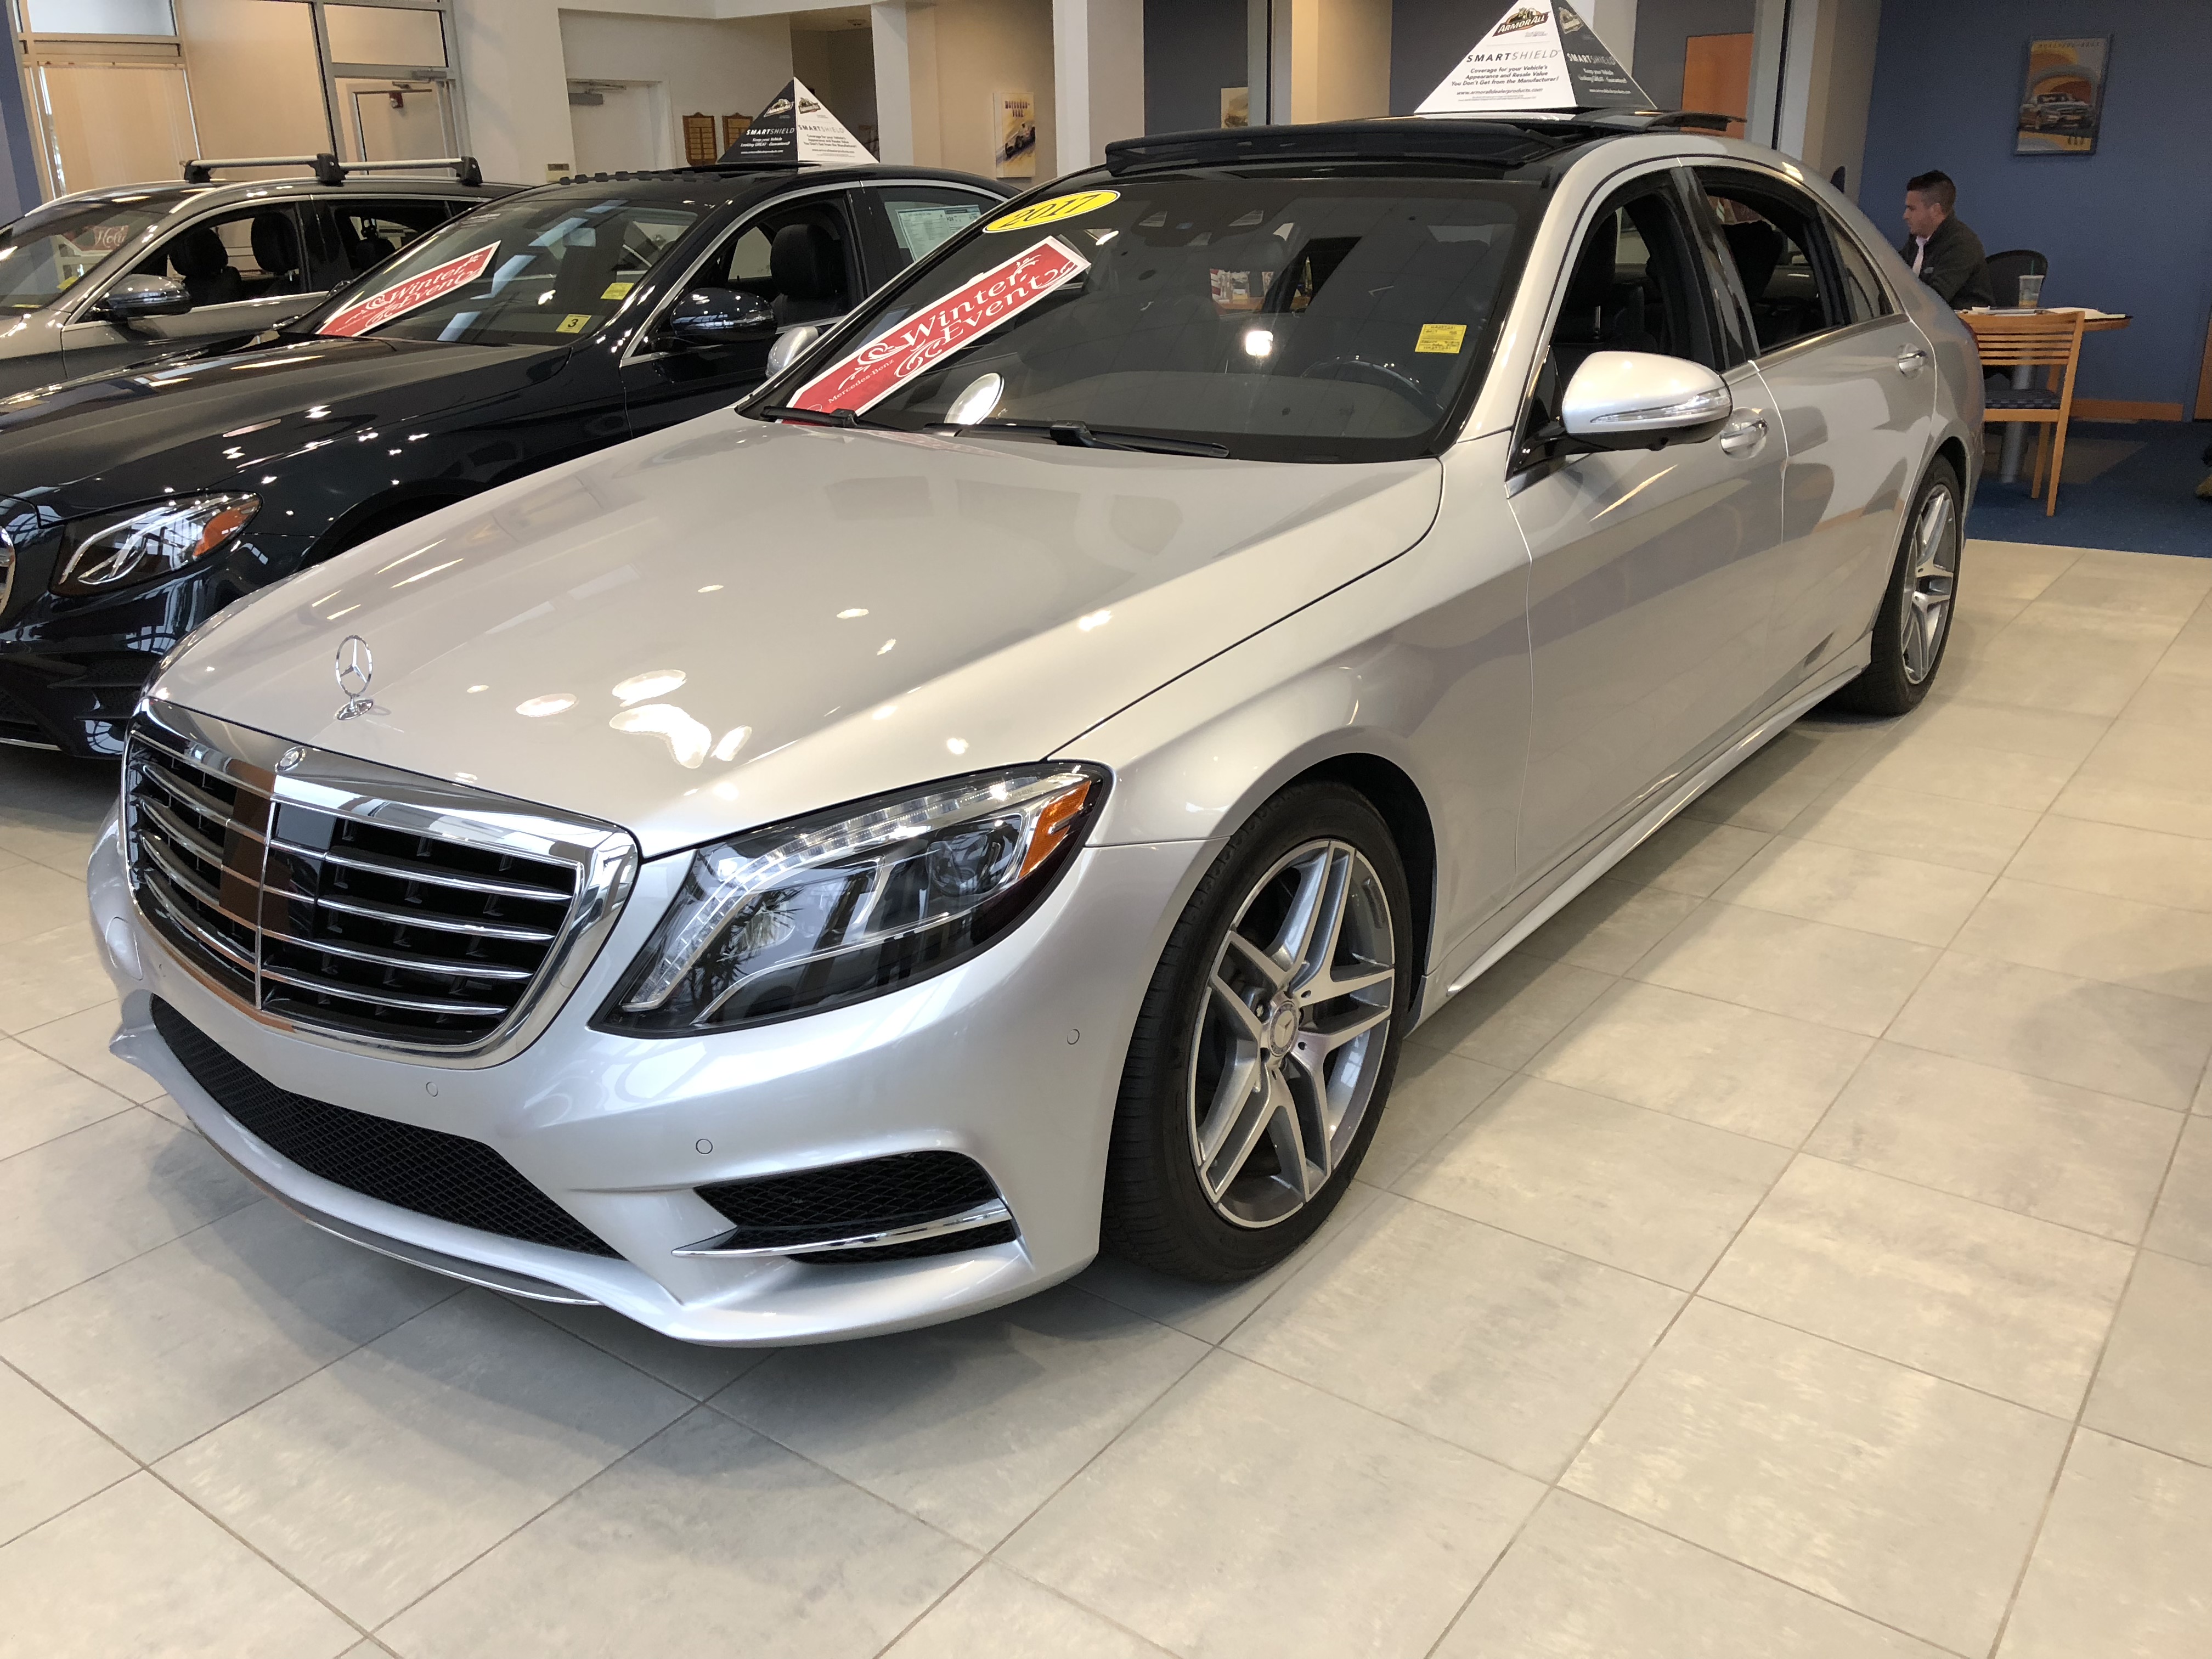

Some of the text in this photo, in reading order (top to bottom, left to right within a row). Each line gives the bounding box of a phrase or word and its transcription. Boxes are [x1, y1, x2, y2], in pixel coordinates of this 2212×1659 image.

[1466, 49, 1558, 63] SMARTSHIELD
[1517, 75, 1559, 83] Manufacturer!
[998, 193, 1103, 228] 2017
[390, 266, 465, 302] Winter
[396, 273, 468, 310] Event
[568, 319, 579, 328] 3
[900, 272, 1028, 346] Winter
[940, 275, 1043, 346] Event
[828, 359, 894, 404] Mercedes-Benz
